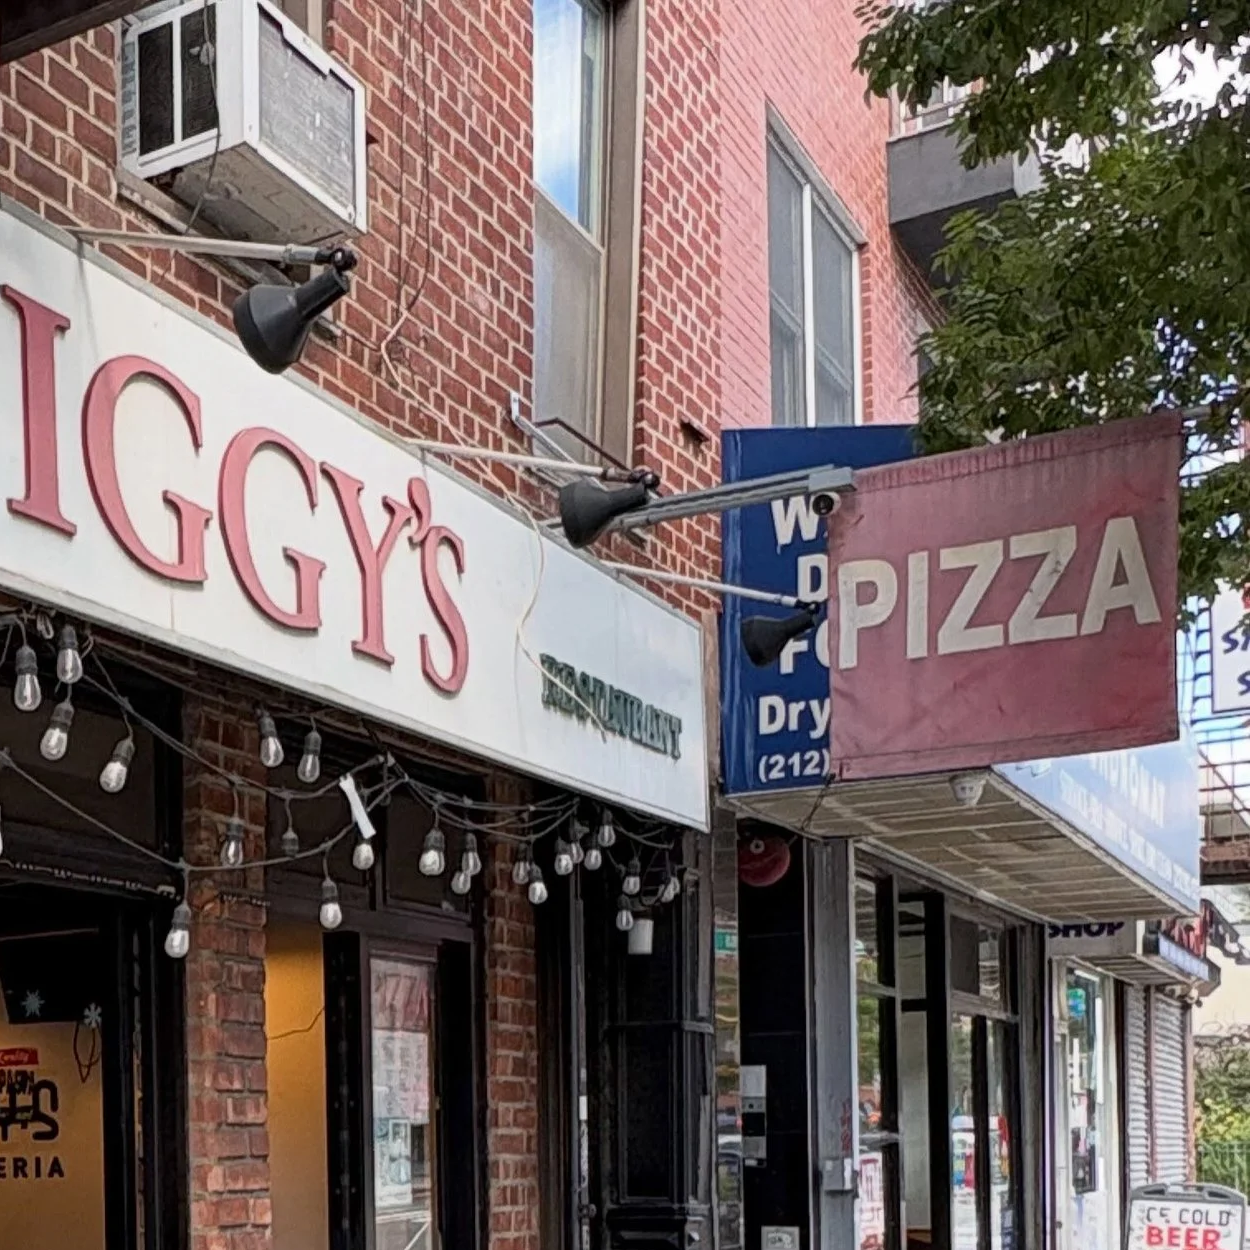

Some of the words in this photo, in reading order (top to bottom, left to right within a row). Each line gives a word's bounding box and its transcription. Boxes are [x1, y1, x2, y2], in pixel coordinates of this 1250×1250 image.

[0, 284, 469, 694] IGGY'S
[771, 495, 828, 549] W
[837, 516, 1162, 670] PIZZA
[758, 695, 831, 740] Dry
[759, 748, 831, 783] (212)
[1146, 1224, 1221, 1250] BEER
[1179, 1208, 1231, 1226] COLD
